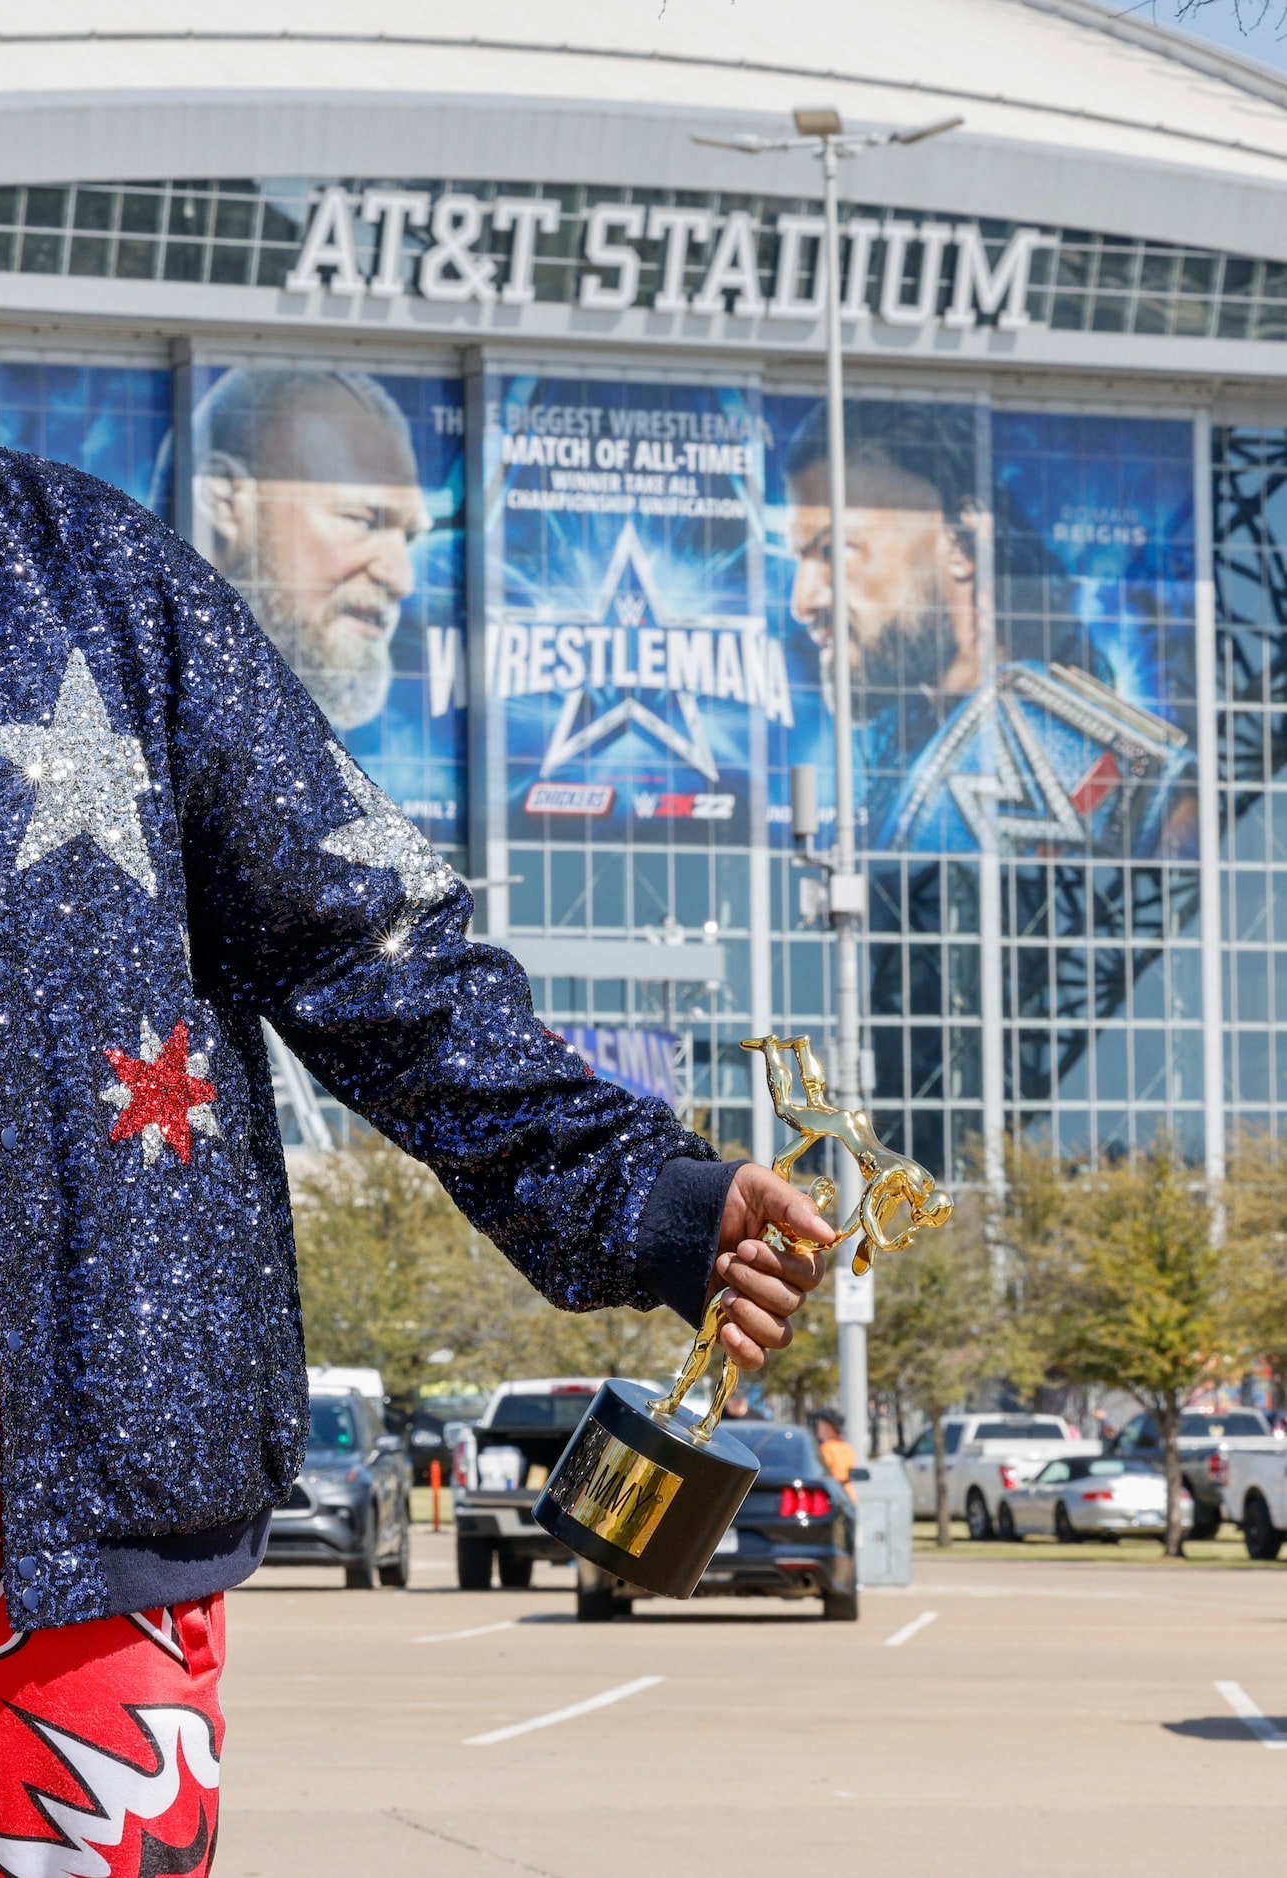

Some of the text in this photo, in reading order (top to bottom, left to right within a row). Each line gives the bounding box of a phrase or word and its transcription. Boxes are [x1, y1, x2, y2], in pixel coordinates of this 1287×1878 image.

[288, 188, 1048, 330] AT&T STADIUM
[505, 403, 603, 437] BIGGEST
[501, 434, 590, 468] MATCH
[595, 438, 629, 470] OF
[508, 489, 636, 513] CHAMPIONSHIP
[550, 470, 698, 498] WINNER TAKE ALL
[1052, 522, 1148, 547] REIGNS
[427, 623, 794, 728] WRESTLEMANA
